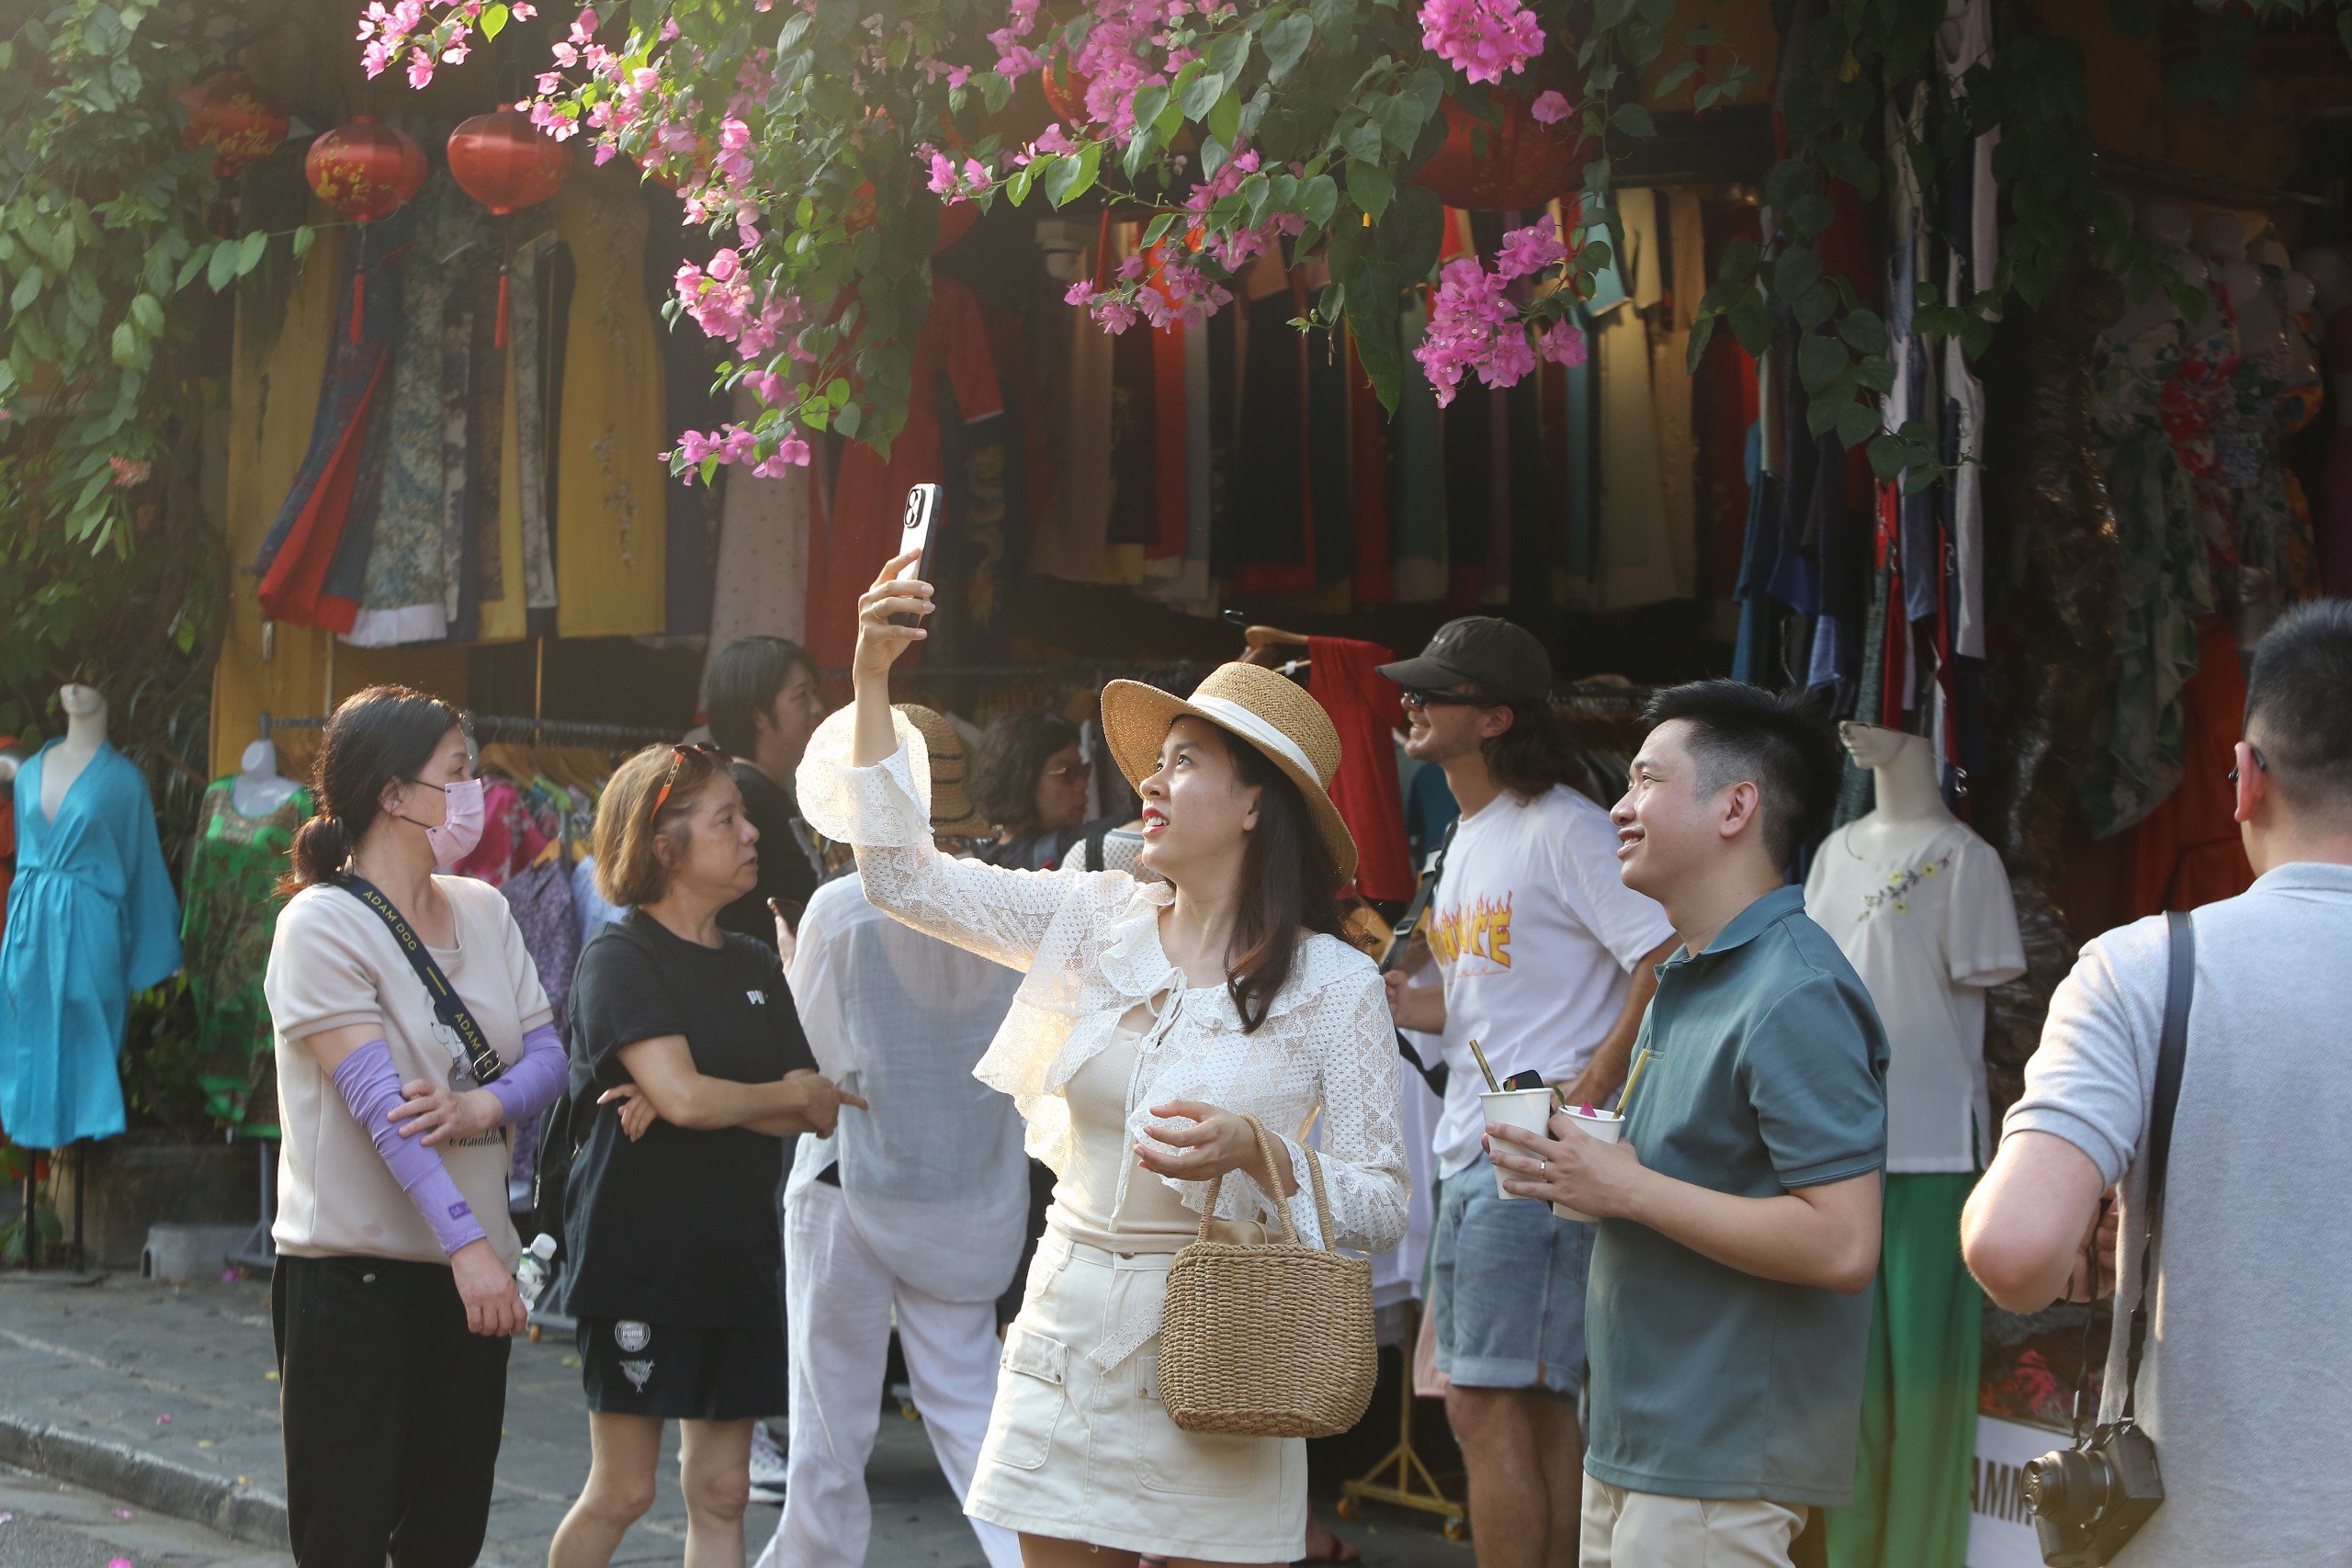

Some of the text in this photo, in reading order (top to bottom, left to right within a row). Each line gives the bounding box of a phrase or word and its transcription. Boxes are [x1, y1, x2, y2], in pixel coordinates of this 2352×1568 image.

[363, 890, 417, 951] ADAM DOG
[746, 990, 765, 1005] PU
[455, 1013, 481, 1050] ADAM
